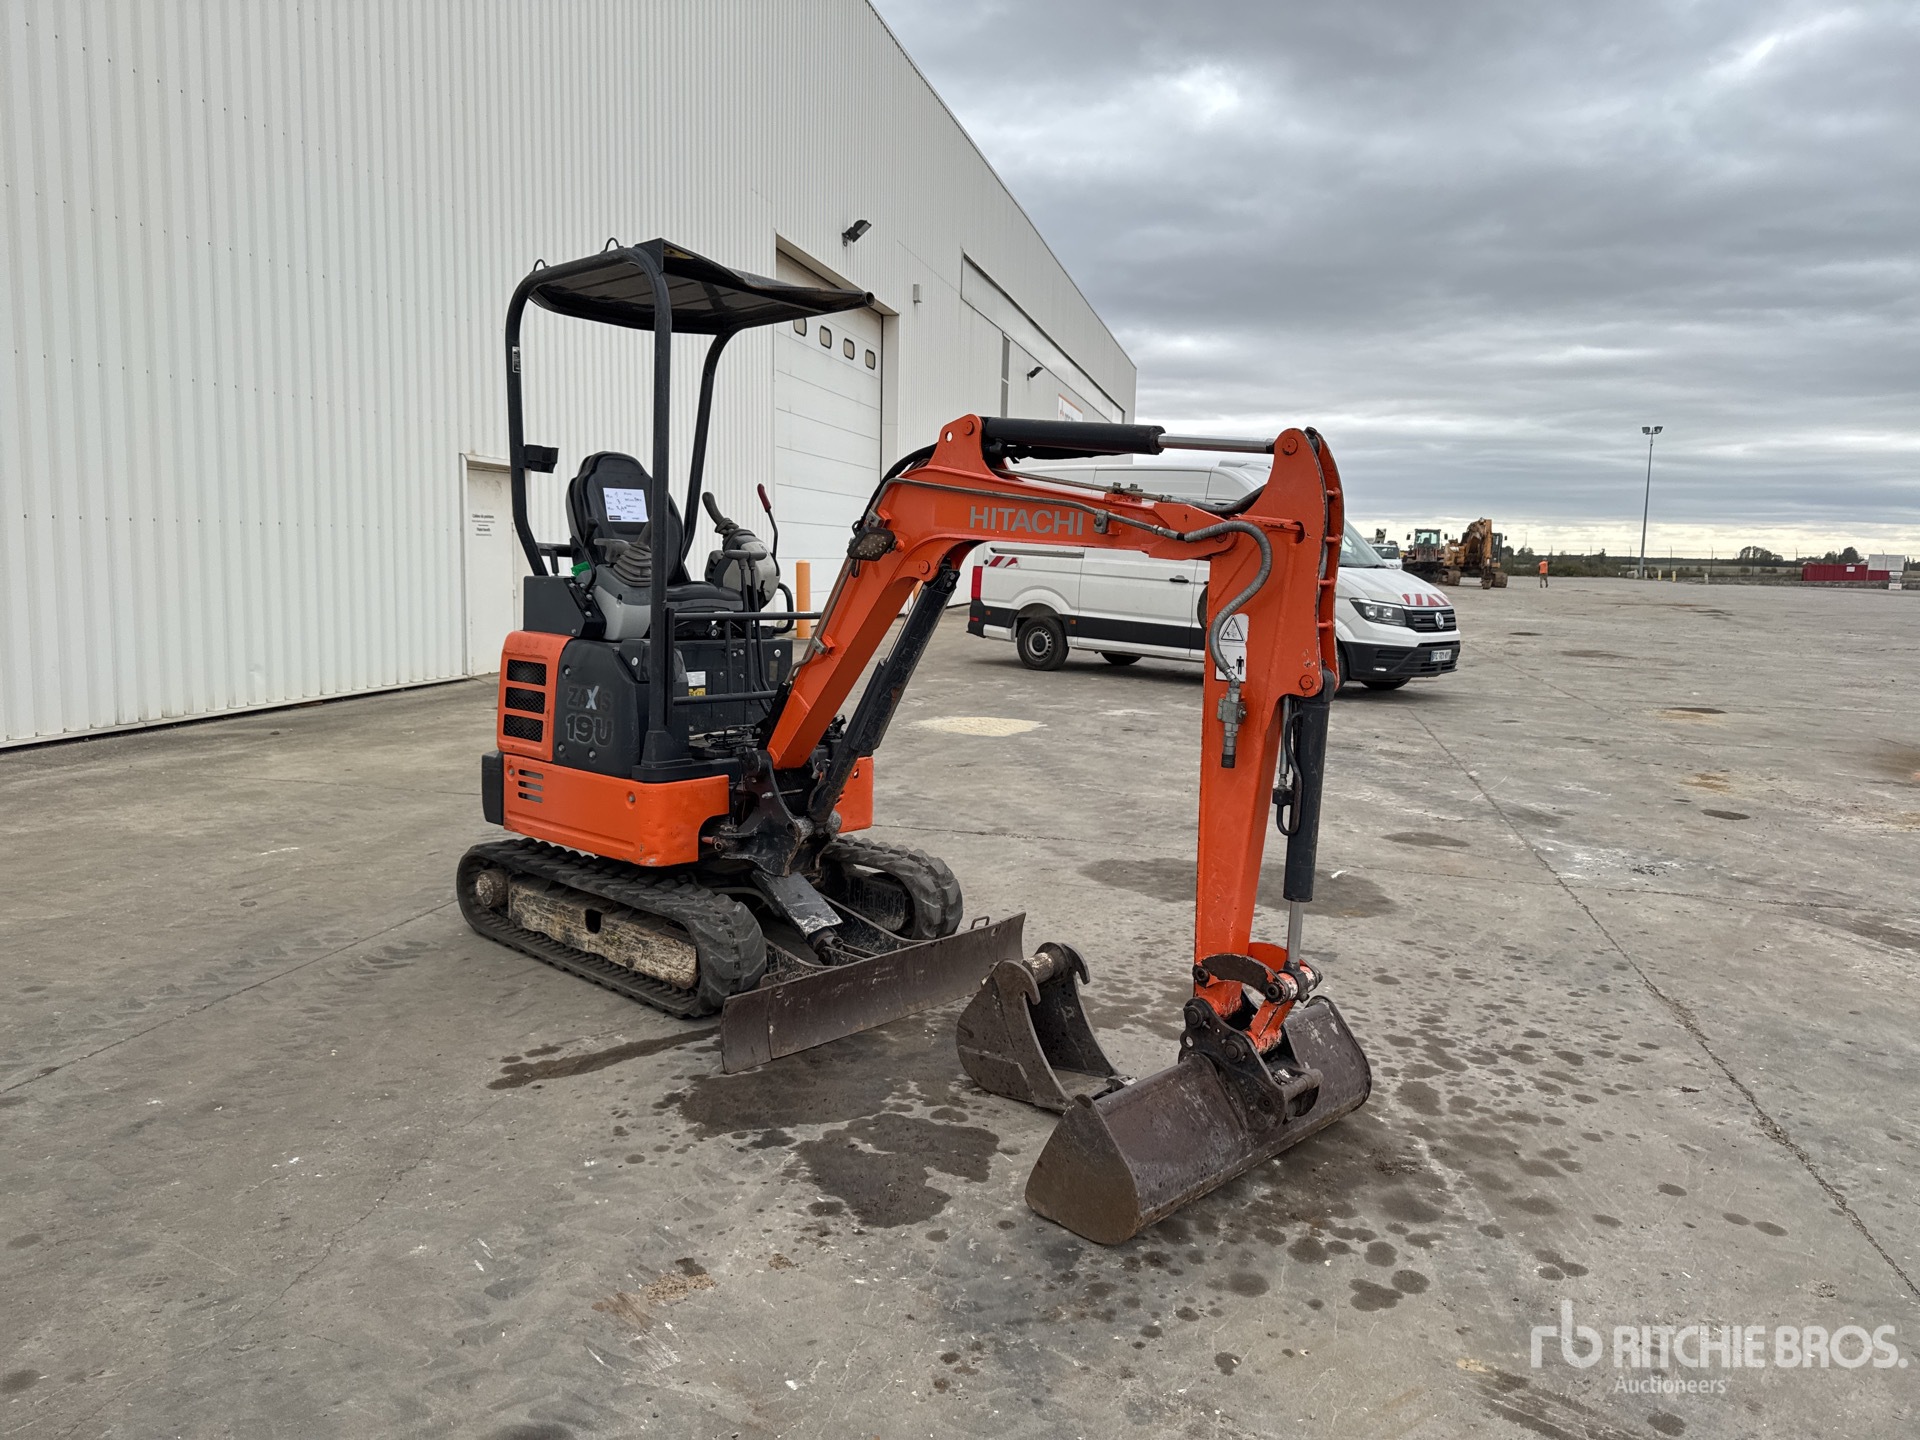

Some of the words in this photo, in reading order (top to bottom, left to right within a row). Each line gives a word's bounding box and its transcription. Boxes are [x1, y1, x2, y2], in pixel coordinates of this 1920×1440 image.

[969, 506, 1084, 536] HITACHI
[567, 685, 614, 713] ZAXIS
[565, 713, 614, 748] 19U
